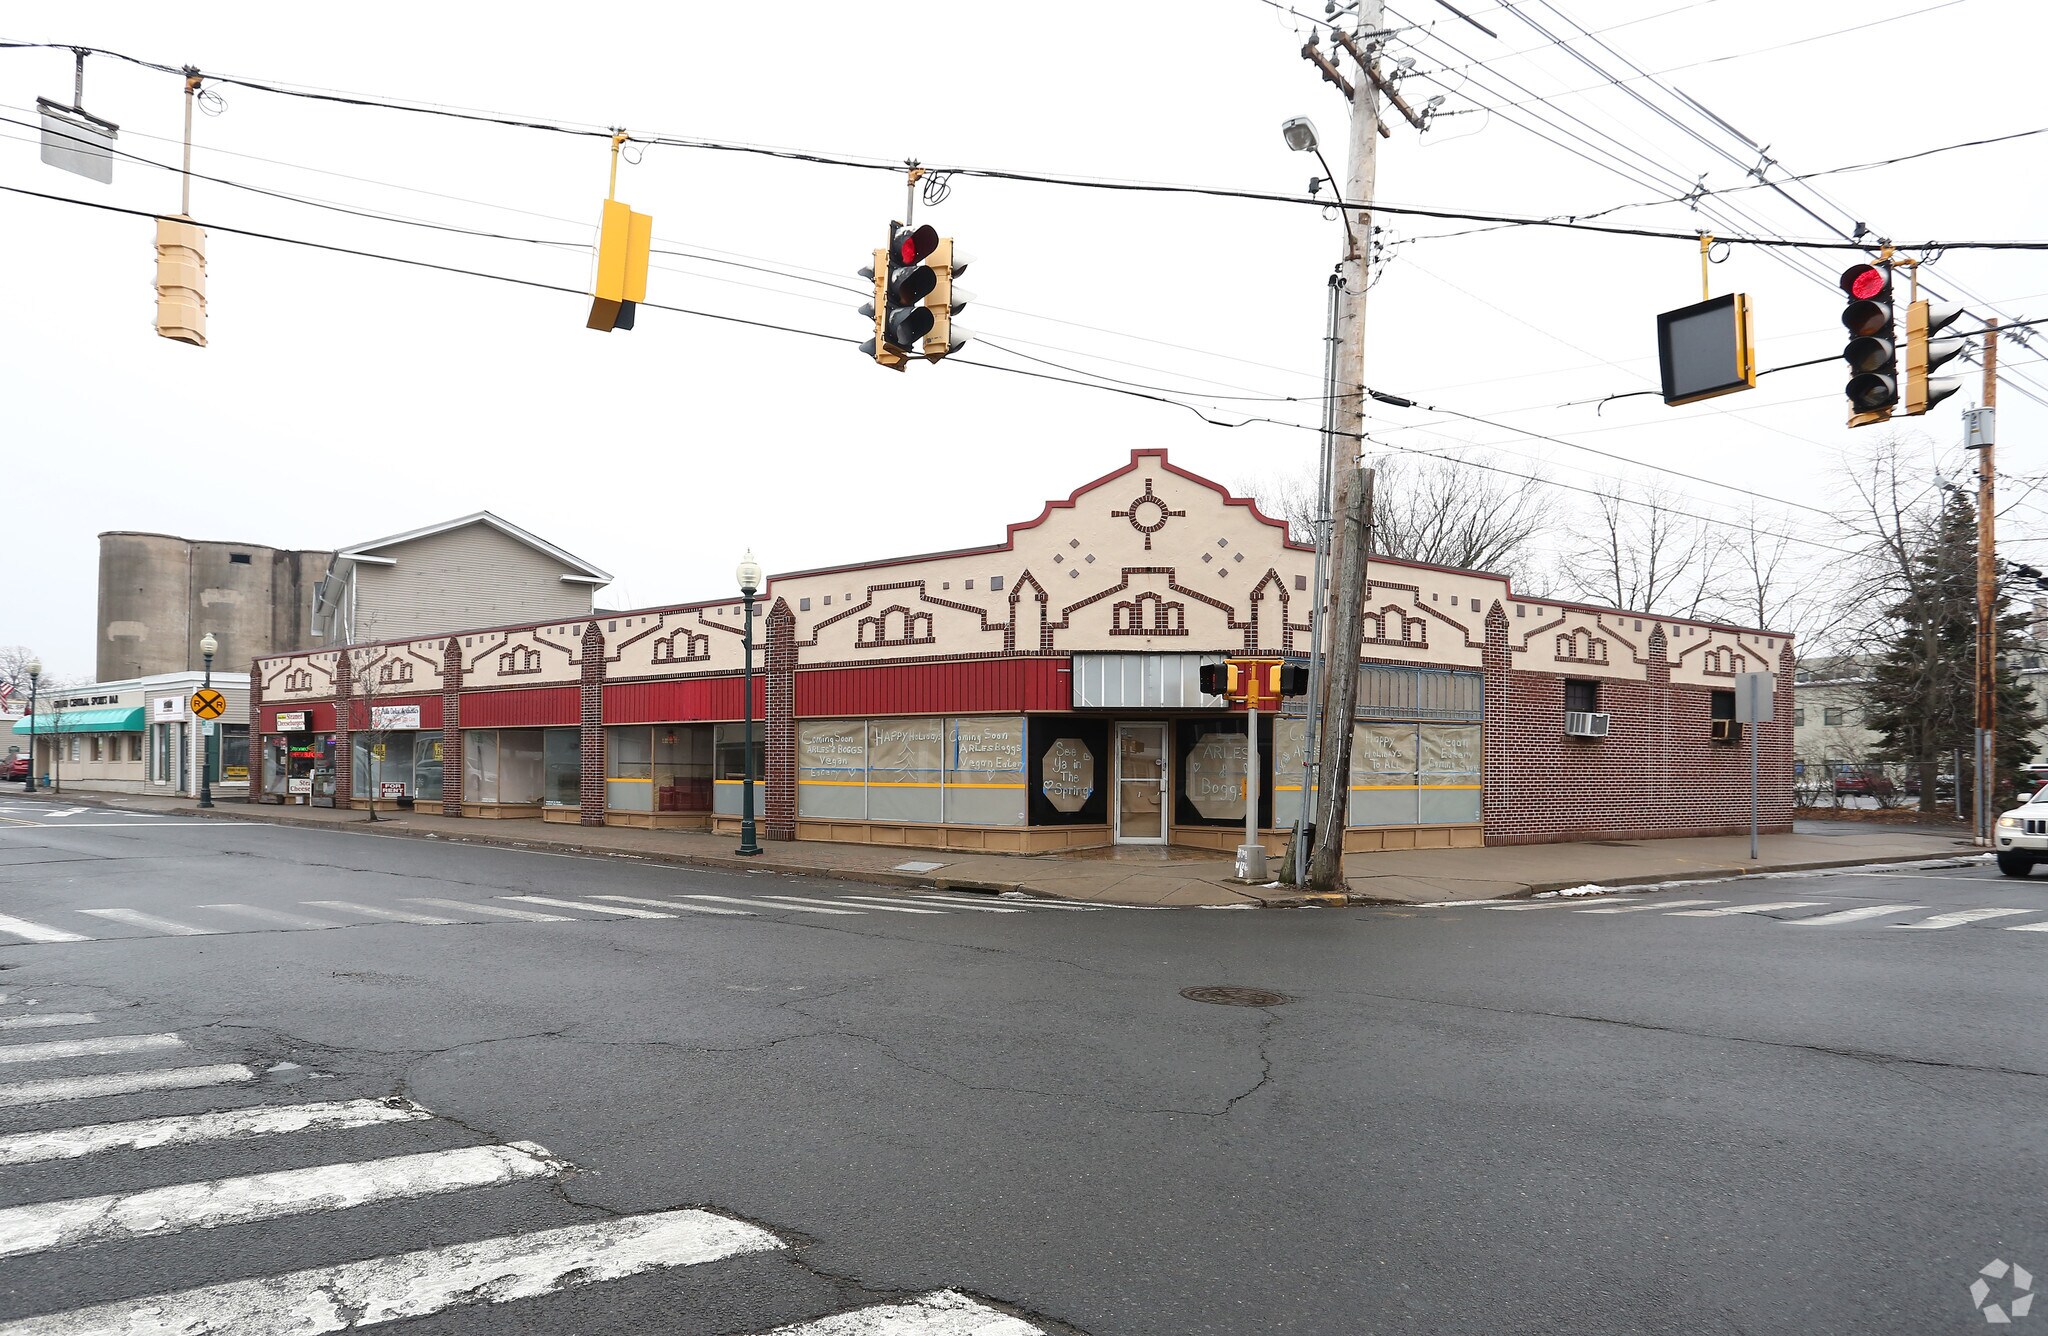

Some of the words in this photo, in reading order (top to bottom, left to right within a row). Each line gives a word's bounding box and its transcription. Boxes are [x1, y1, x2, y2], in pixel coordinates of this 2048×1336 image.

[109, 695, 118, 704] BAR
[801, 730, 833, 747] Coming
[834, 731, 854, 743] Soon
[875, 728, 908, 746] HAPPY
[949, 729, 981, 744] Coming
[984, 728, 1008, 740] Soon
[1365, 731, 1395, 748] Happy
[958, 743, 993, 753] ARLES
[994, 743, 1023, 755] Boggs
[1056, 741, 1077, 756] See
[820, 756, 848, 768] Vegan
[960, 757, 993, 769] Vegan
[1052, 757, 1067, 772] Ya
[1073, 759, 1081, 769] in
[1384, 760, 1400, 769] ALL
[1060, 771, 1079, 782] The
